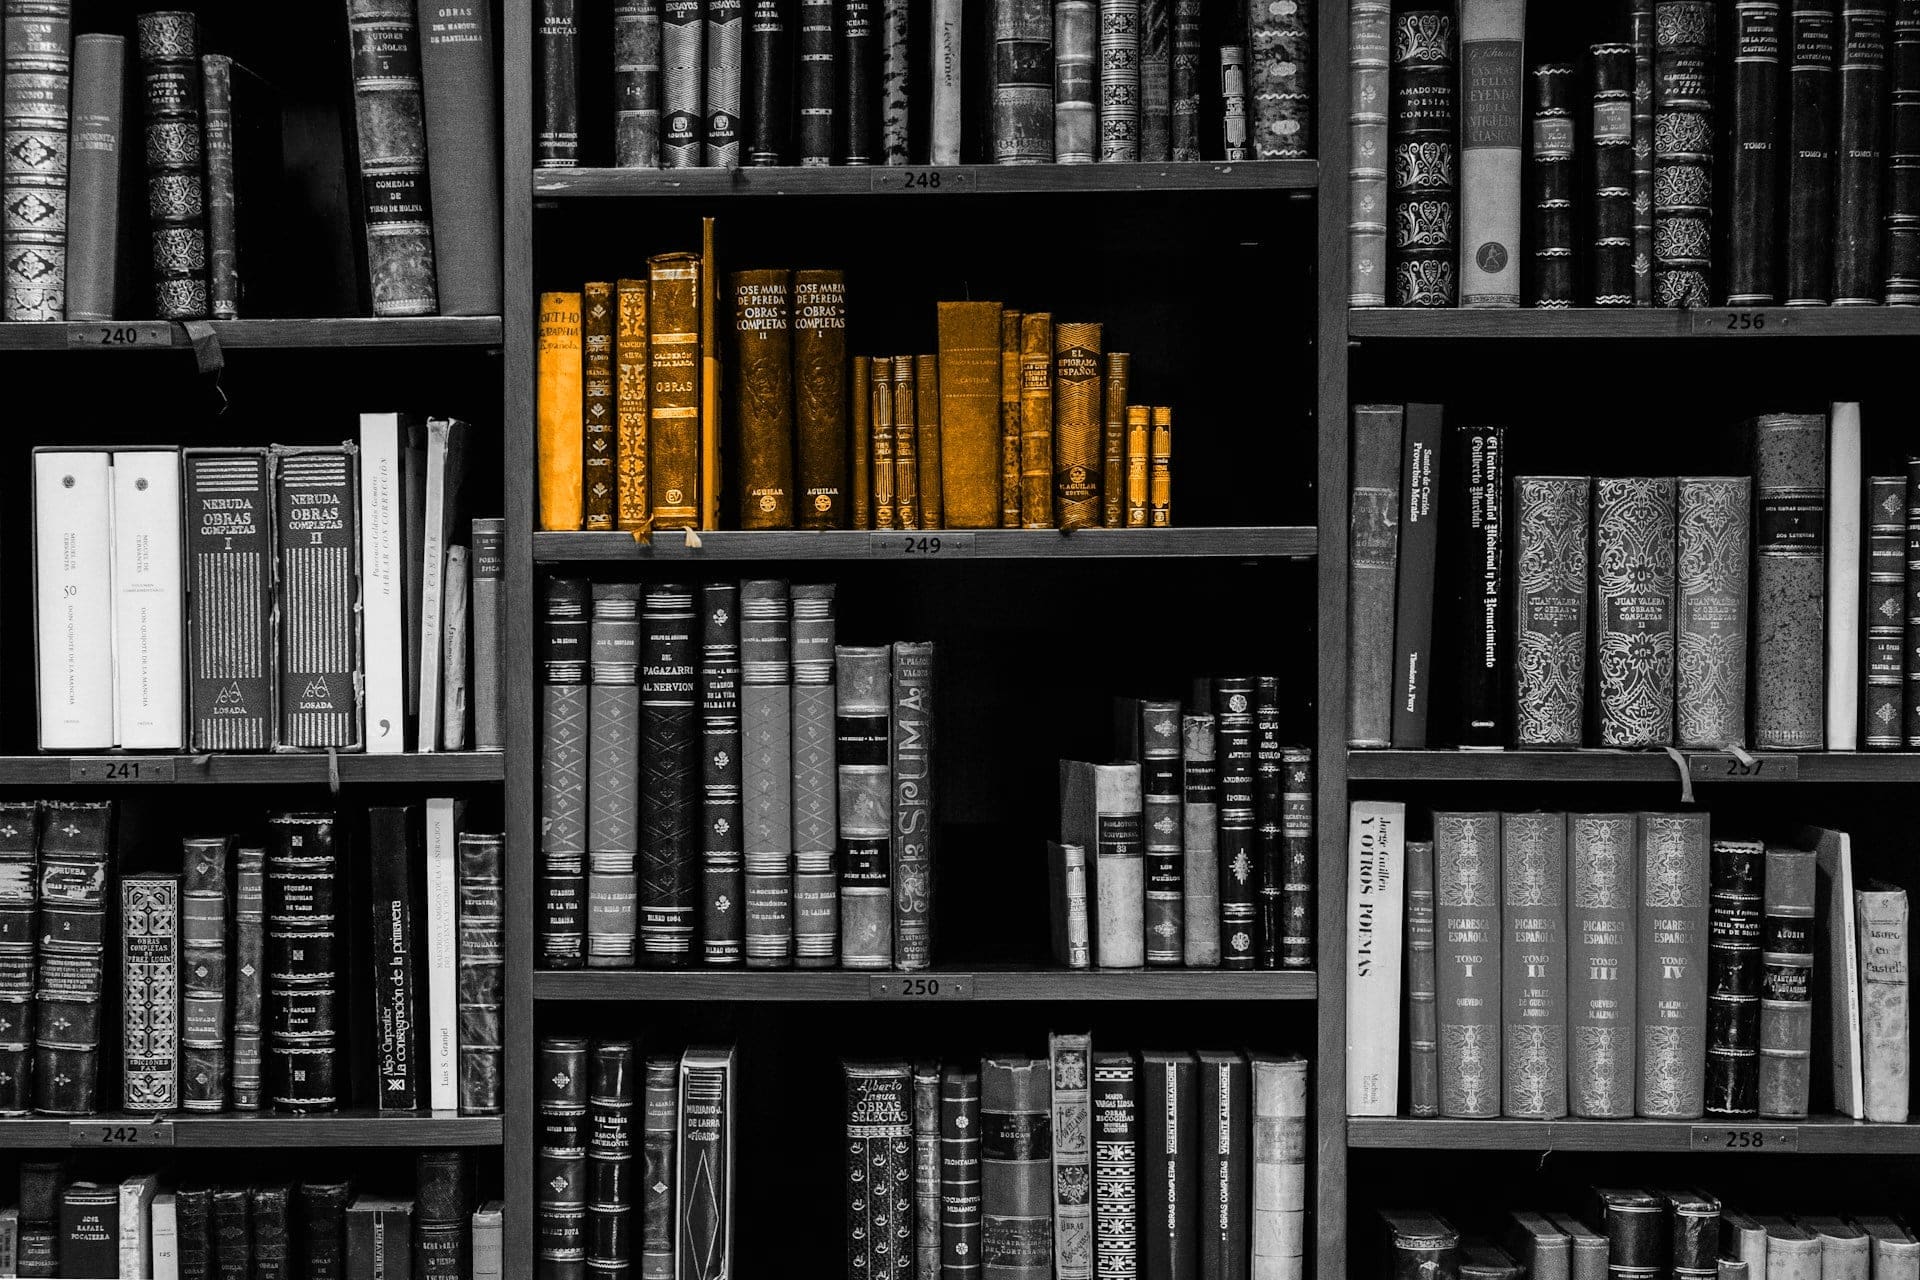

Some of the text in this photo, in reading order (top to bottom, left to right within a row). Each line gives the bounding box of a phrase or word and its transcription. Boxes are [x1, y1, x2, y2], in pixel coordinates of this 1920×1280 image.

[665, 2, 698, 11] ENSAYOS
[709, 1, 741, 10] ENSAYOS
[438, 8, 472, 17] OBRAS
[544, 17, 573, 25] OBRAS
[1743, 142, 1767, 150] TOMO
[904, 172, 941, 188] 248
[390, 192, 401, 200] DE
[738, 296, 785, 306] DE PEREDA
[797, 294, 844, 304] DE PEREDA
[744, 307, 778, 318] OBRAS
[803, 306, 836, 317] OBRAS
[736, 318, 787, 331] COMPLETAS
[795, 317, 845, 330] COMPLETAS
[1727, 313, 1765, 330] 256
[101, 328, 137, 345] 240
[759, 332, 767, 340] II
[818, 330, 823, 338] I
[1071, 349, 1084, 358] EL
[1058, 366, 1097, 376] ESPAÑOL
[655, 381, 693, 393] OBRAS
[1410, 442, 1422, 522] Proverbios Morales
[1421, 448, 1432, 515] Santob de Carrión
[752, 488, 784, 496] AGUILAR
[807, 488, 838, 496] AGUILAR
[202, 499, 253, 510] NERUDA
[290, 494, 340, 505] NERUDA
[203, 513, 252, 526] OBRAS
[291, 508, 339, 521] OBRAS
[201, 525, 256, 535] COMPLETAS
[289, 520, 344, 530] COMPLETAS
[310, 531, 323, 544] II
[224, 537, 232, 550] I
[905, 537, 941, 553] 249
[1486, 581, 1497, 595] del
[1614, 597, 1666, 606] JUAN VALERA
[1484, 598, 1497, 668] Renacimiento
[643, 666, 694, 675] PAGAZARRI
[653, 682, 694, 691] NERVION
[106, 762, 139, 778] 241
[1377, 817, 1391, 846] Jorge
[1357, 816, 1375, 978] Y OTROS POEMAS
[63, 922, 71, 931] 2
[1447, 918, 1490, 930] PICARESCA
[1514, 918, 1556, 930] PICARESCA
[1583, 920, 1624, 931] PICARESCA
[1654, 919, 1695, 931] PICARESCA
[1448, 931, 1488, 942] ESPAÑOLA
[1515, 931, 1555, 942] ESPAÑOLA
[1583, 933, 1624, 944] ESPAÑOLA
[1654, 932, 1694, 943] ESPAÑOLA
[1455, 955, 1483, 963] TOMO
[1522, 955, 1549, 963] TOMO
[1589, 957, 1618, 966] TOMO
[1659, 956, 1688, 965] TOMO
[1464, 964, 1474, 978] I
[1527, 964, 1545, 978] II
[1589, 966, 1618, 980] III
[1663, 965, 1686, 979] IV
[389, 895, 410, 1076] La consagración de la primavera
[902, 980, 939, 995] 250
[1456, 998, 1483, 1007] QUEVEDO
[1590, 1000, 1617, 1008] QUEVEDO
[382, 1006, 395, 1076] Alejo Carpentier
[439, 1028, 449, 1057] Granjel
[857, 1079, 902, 1091] Alberto
[686, 1104, 717, 1114] MARIANO
[856, 1101, 902, 1112] OBRAS
[851, 1111, 908, 1122] SELECTAS
[688, 1118, 721, 1128] DE LARRA
[102, 1127, 138, 1142] 242
[1167, 1121, 1176, 1154] VICENTE
[1220, 1122, 1228, 1154] VICENTE
[1726, 1132, 1763, 1147] 258
[1168, 1160, 1176, 1229] OBRAS COMPLETAS
[1220, 1160, 1228, 1229] OBRAS COMPLETAS
